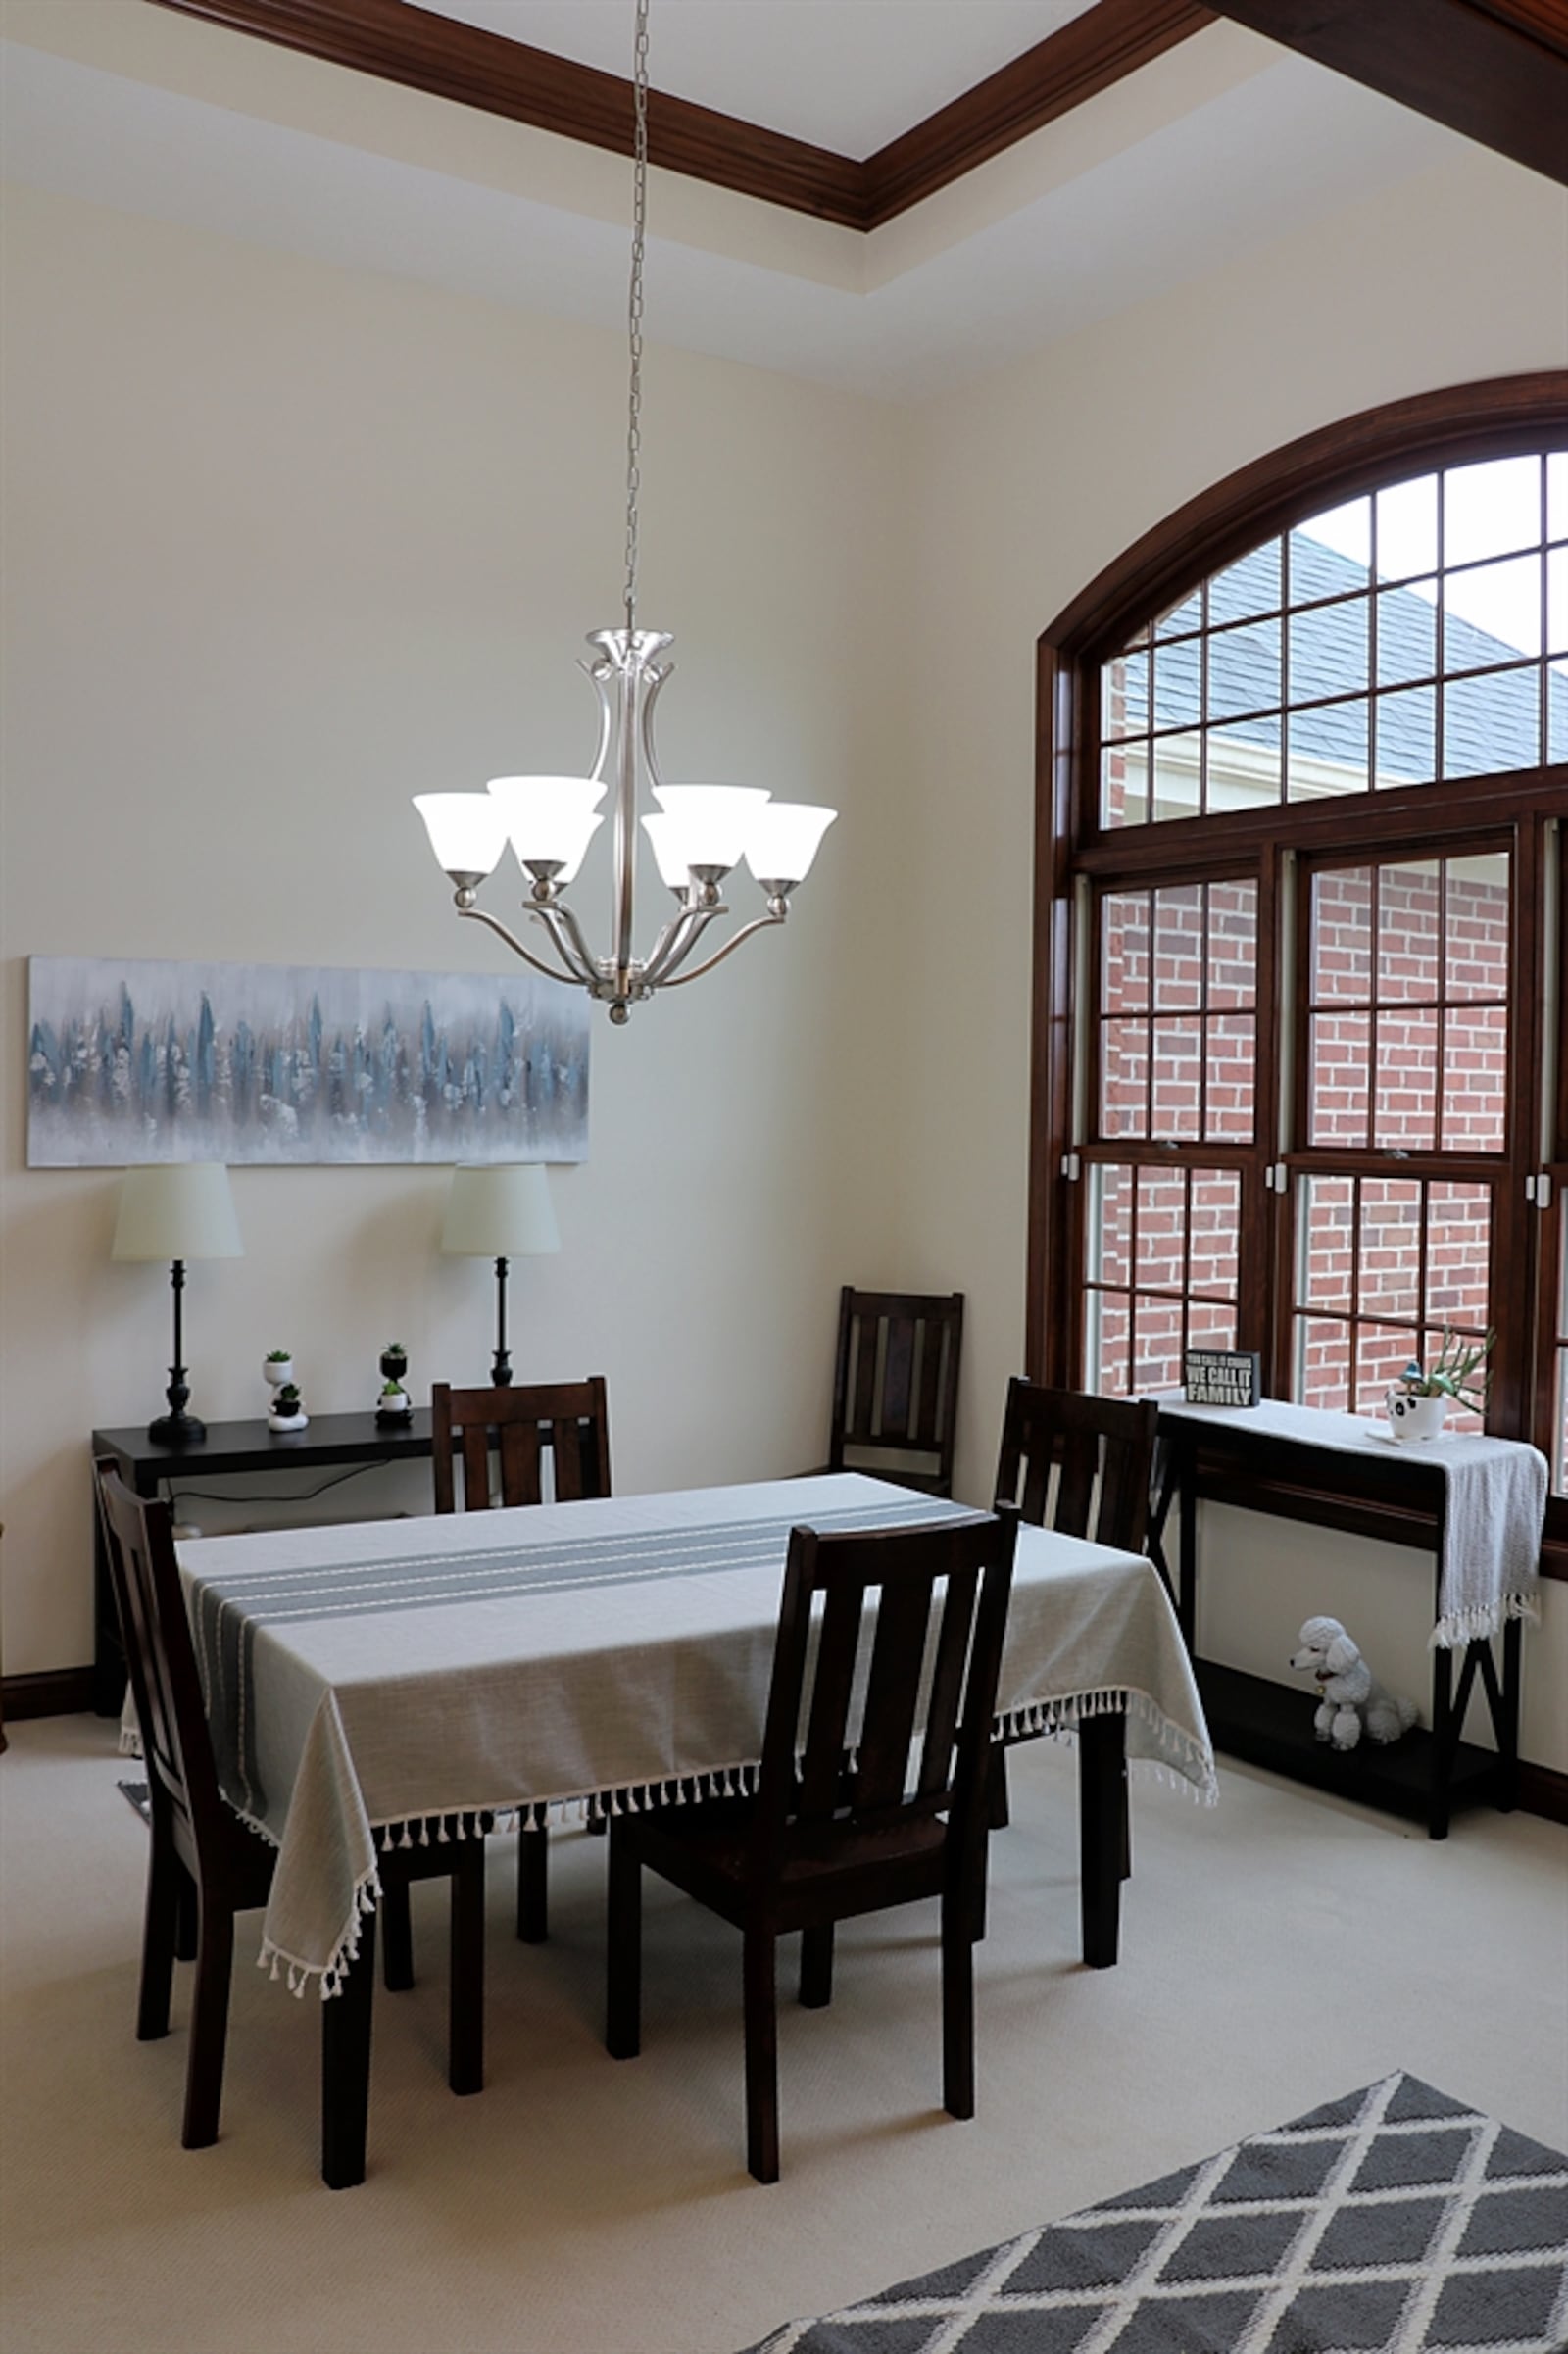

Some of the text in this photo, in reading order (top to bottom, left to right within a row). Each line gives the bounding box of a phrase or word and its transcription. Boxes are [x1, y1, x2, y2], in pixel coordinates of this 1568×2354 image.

[1186, 1365, 1251, 1387] WE CALL IT
[1187, 1383, 1251, 1406] FAMILY
